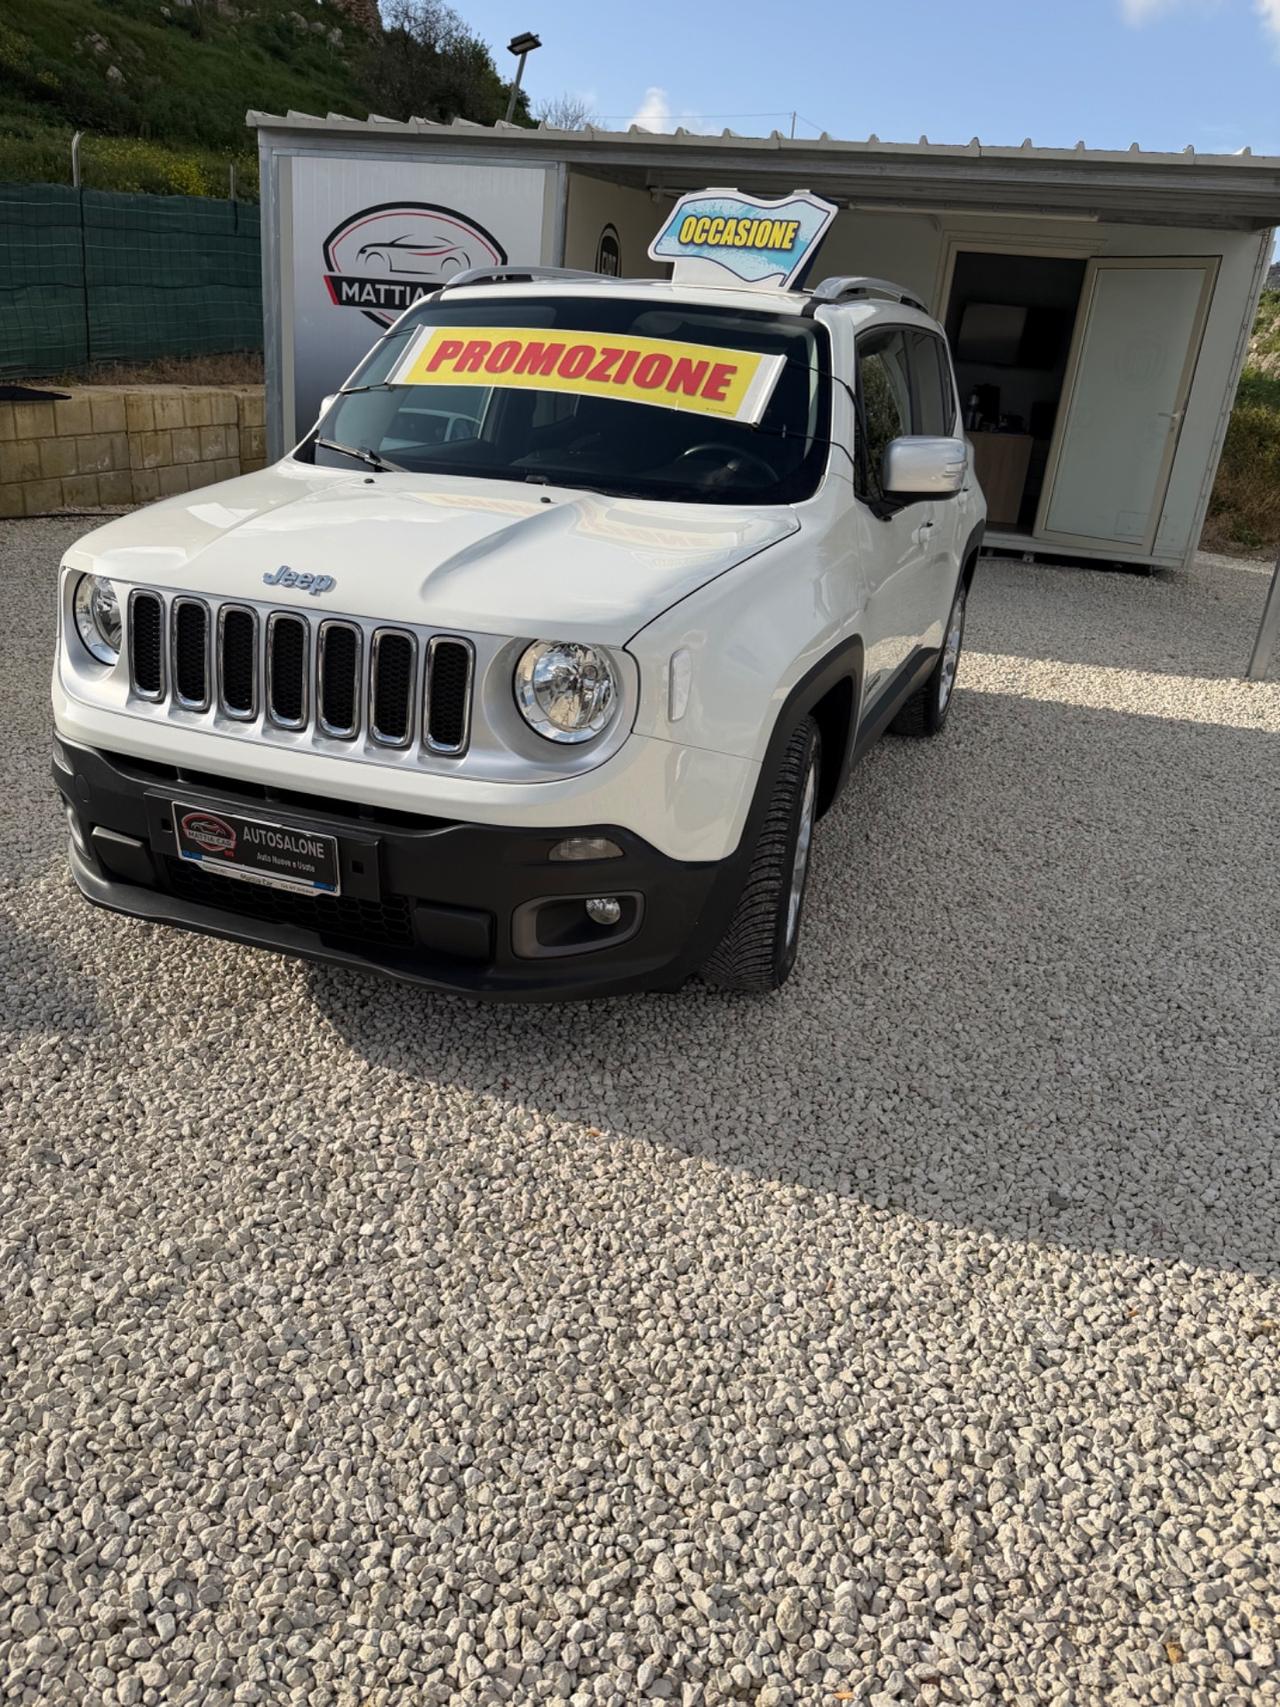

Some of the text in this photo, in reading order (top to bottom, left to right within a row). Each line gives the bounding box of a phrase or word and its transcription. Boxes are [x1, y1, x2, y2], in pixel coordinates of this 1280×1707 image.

[679, 215, 799, 250] OCCASIONE
[341, 281, 425, 306] MATTIA
[425, 340, 738, 401] PROMOZIONE
[262, 565, 337, 596] Jeep
[243, 826, 325, 859] AUTOSALONE
